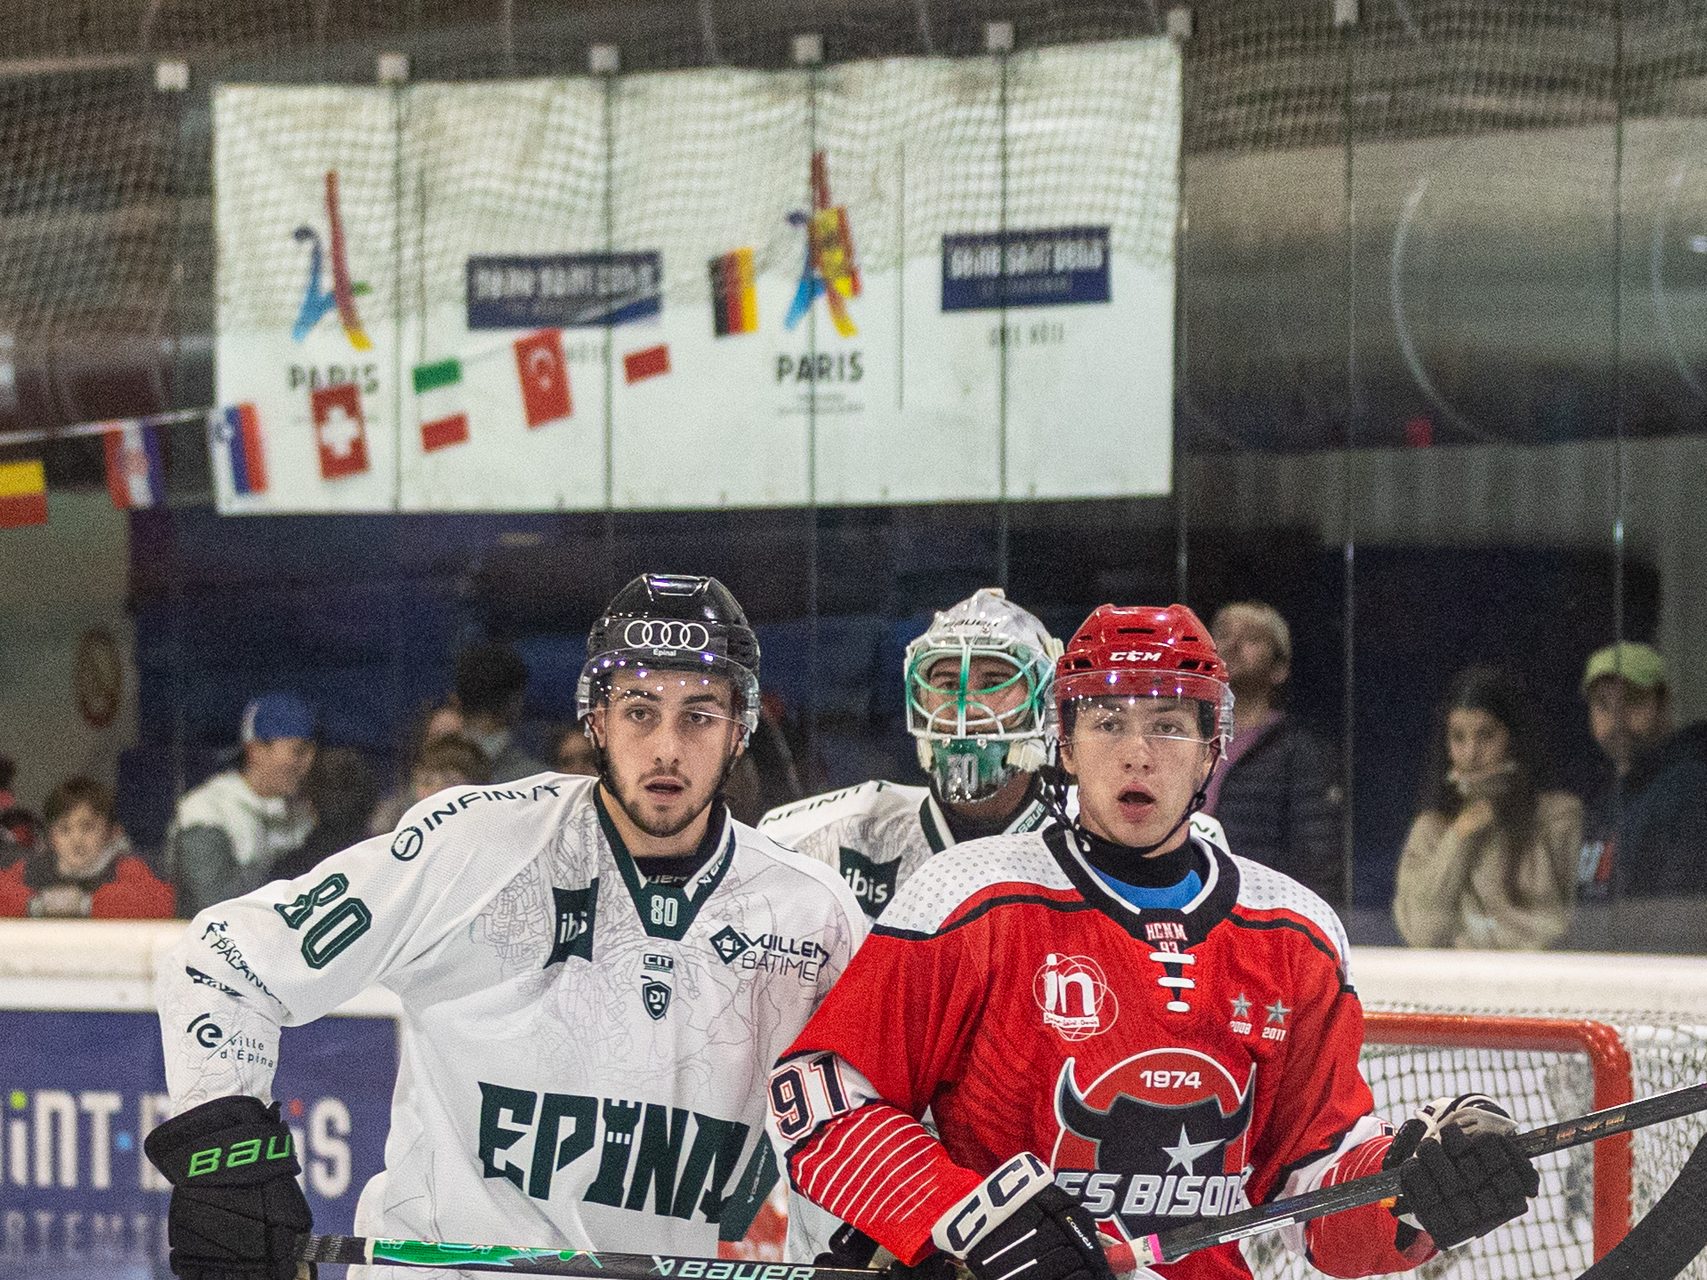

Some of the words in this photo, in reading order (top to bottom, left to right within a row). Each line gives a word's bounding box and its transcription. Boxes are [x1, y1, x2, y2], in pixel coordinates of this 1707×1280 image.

[775, 351, 864, 385] PARIS
[1109, 650, 1163, 662] CCM
[650, 894, 679, 927] 80
[274, 873, 373, 970] 80
[1145, 922, 1188, 941] HCNM
[644, 955, 674, 968] CIT
[1261, 1026, 1287, 1042] 2011
[1139, 1070, 1202, 1090] 1974
[768, 1053, 851, 1141] 91
